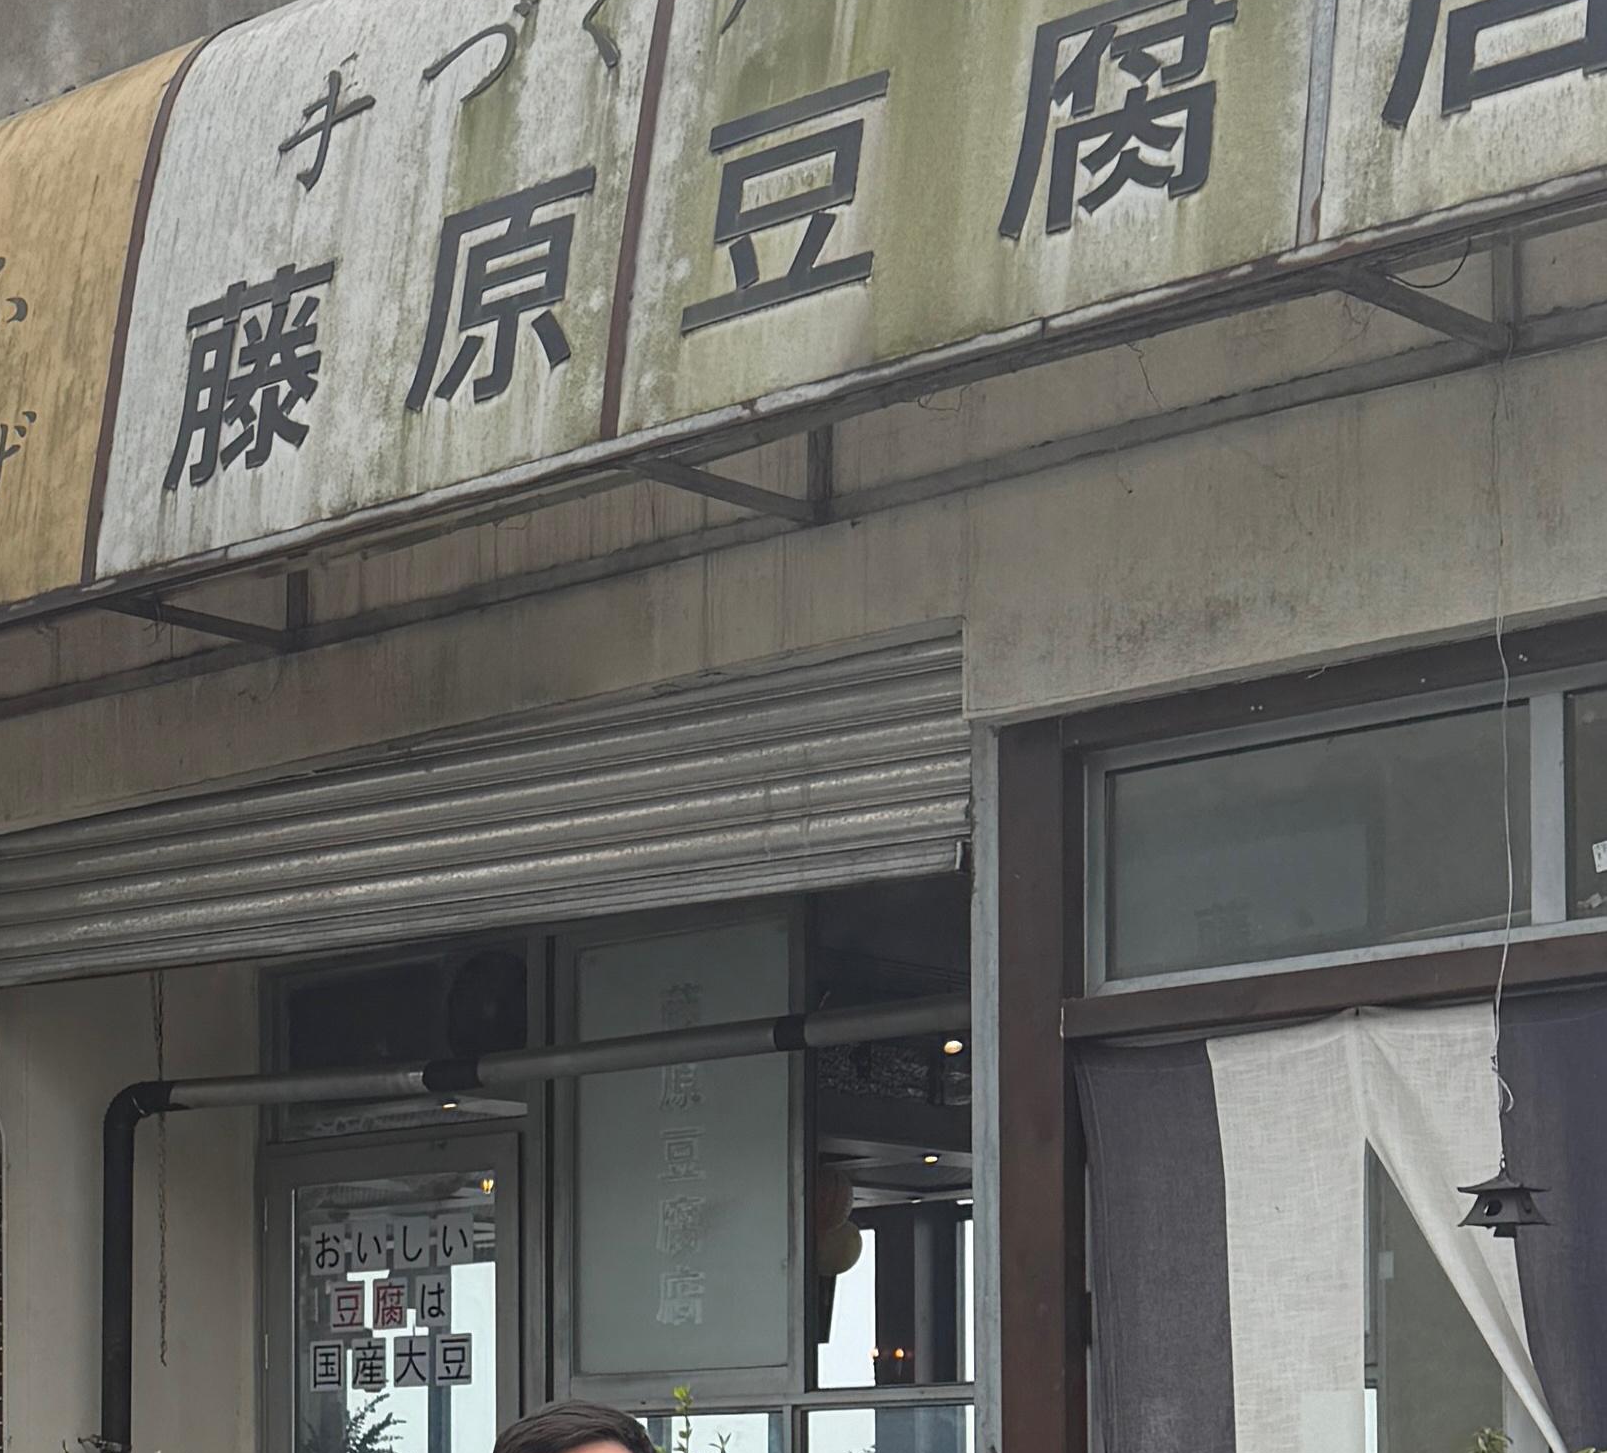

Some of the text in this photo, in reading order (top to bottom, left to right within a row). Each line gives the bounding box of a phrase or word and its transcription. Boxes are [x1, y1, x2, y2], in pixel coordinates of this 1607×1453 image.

[314, 1224, 469, 1269] おいしい
[332, 1281, 447, 1328] 豆腐は
[312, 1337, 473, 1388] 国産大豆
